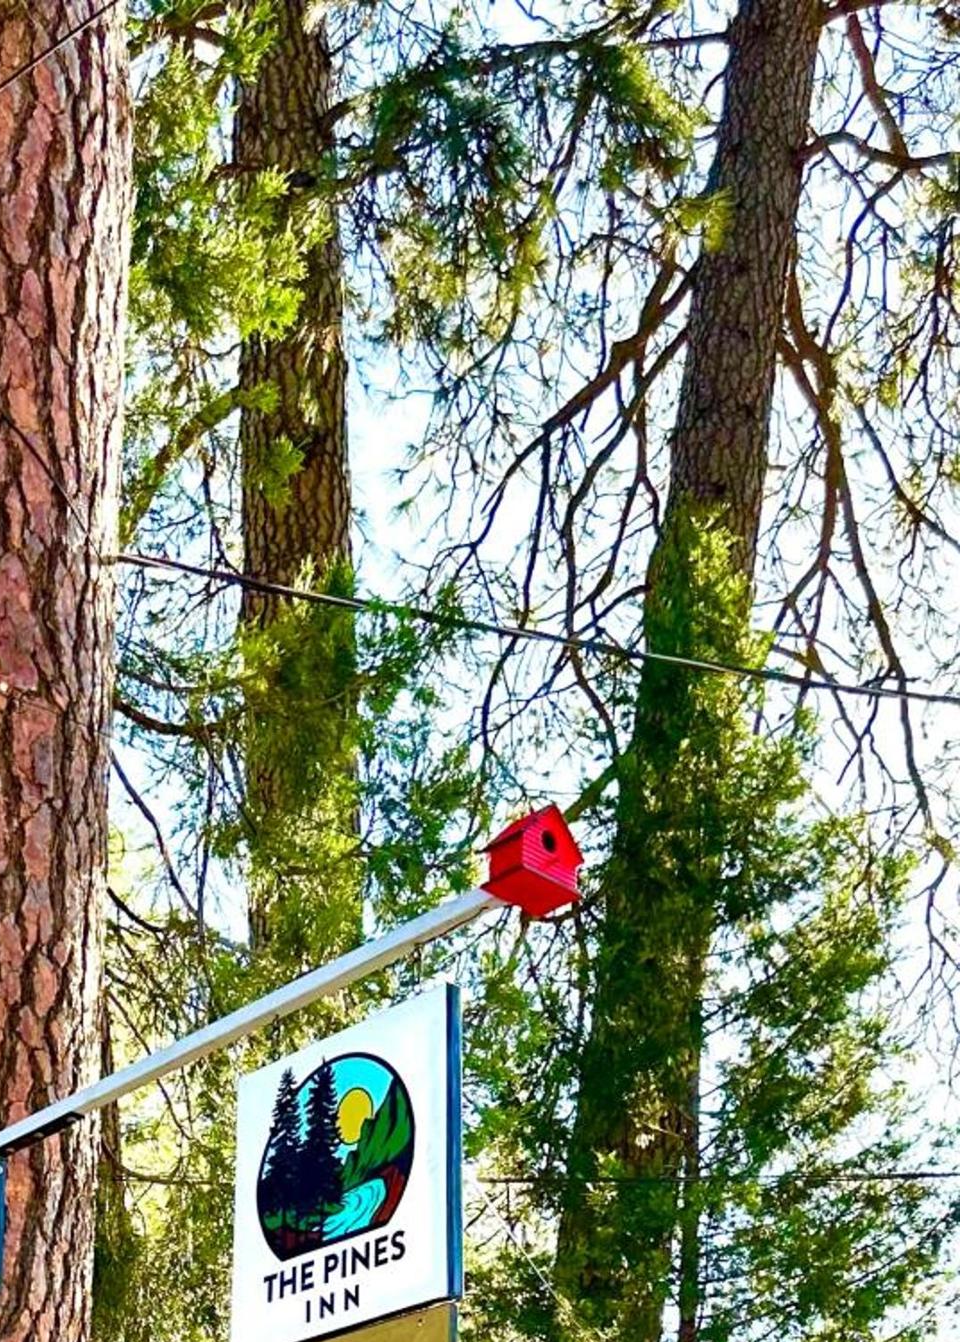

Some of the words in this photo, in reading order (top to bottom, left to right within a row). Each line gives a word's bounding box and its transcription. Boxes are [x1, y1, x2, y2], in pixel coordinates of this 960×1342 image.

[263, 1260, 315, 1303] THE
[324, 1230, 406, 1284] PINES
[306, 1284, 360, 1323] INN
